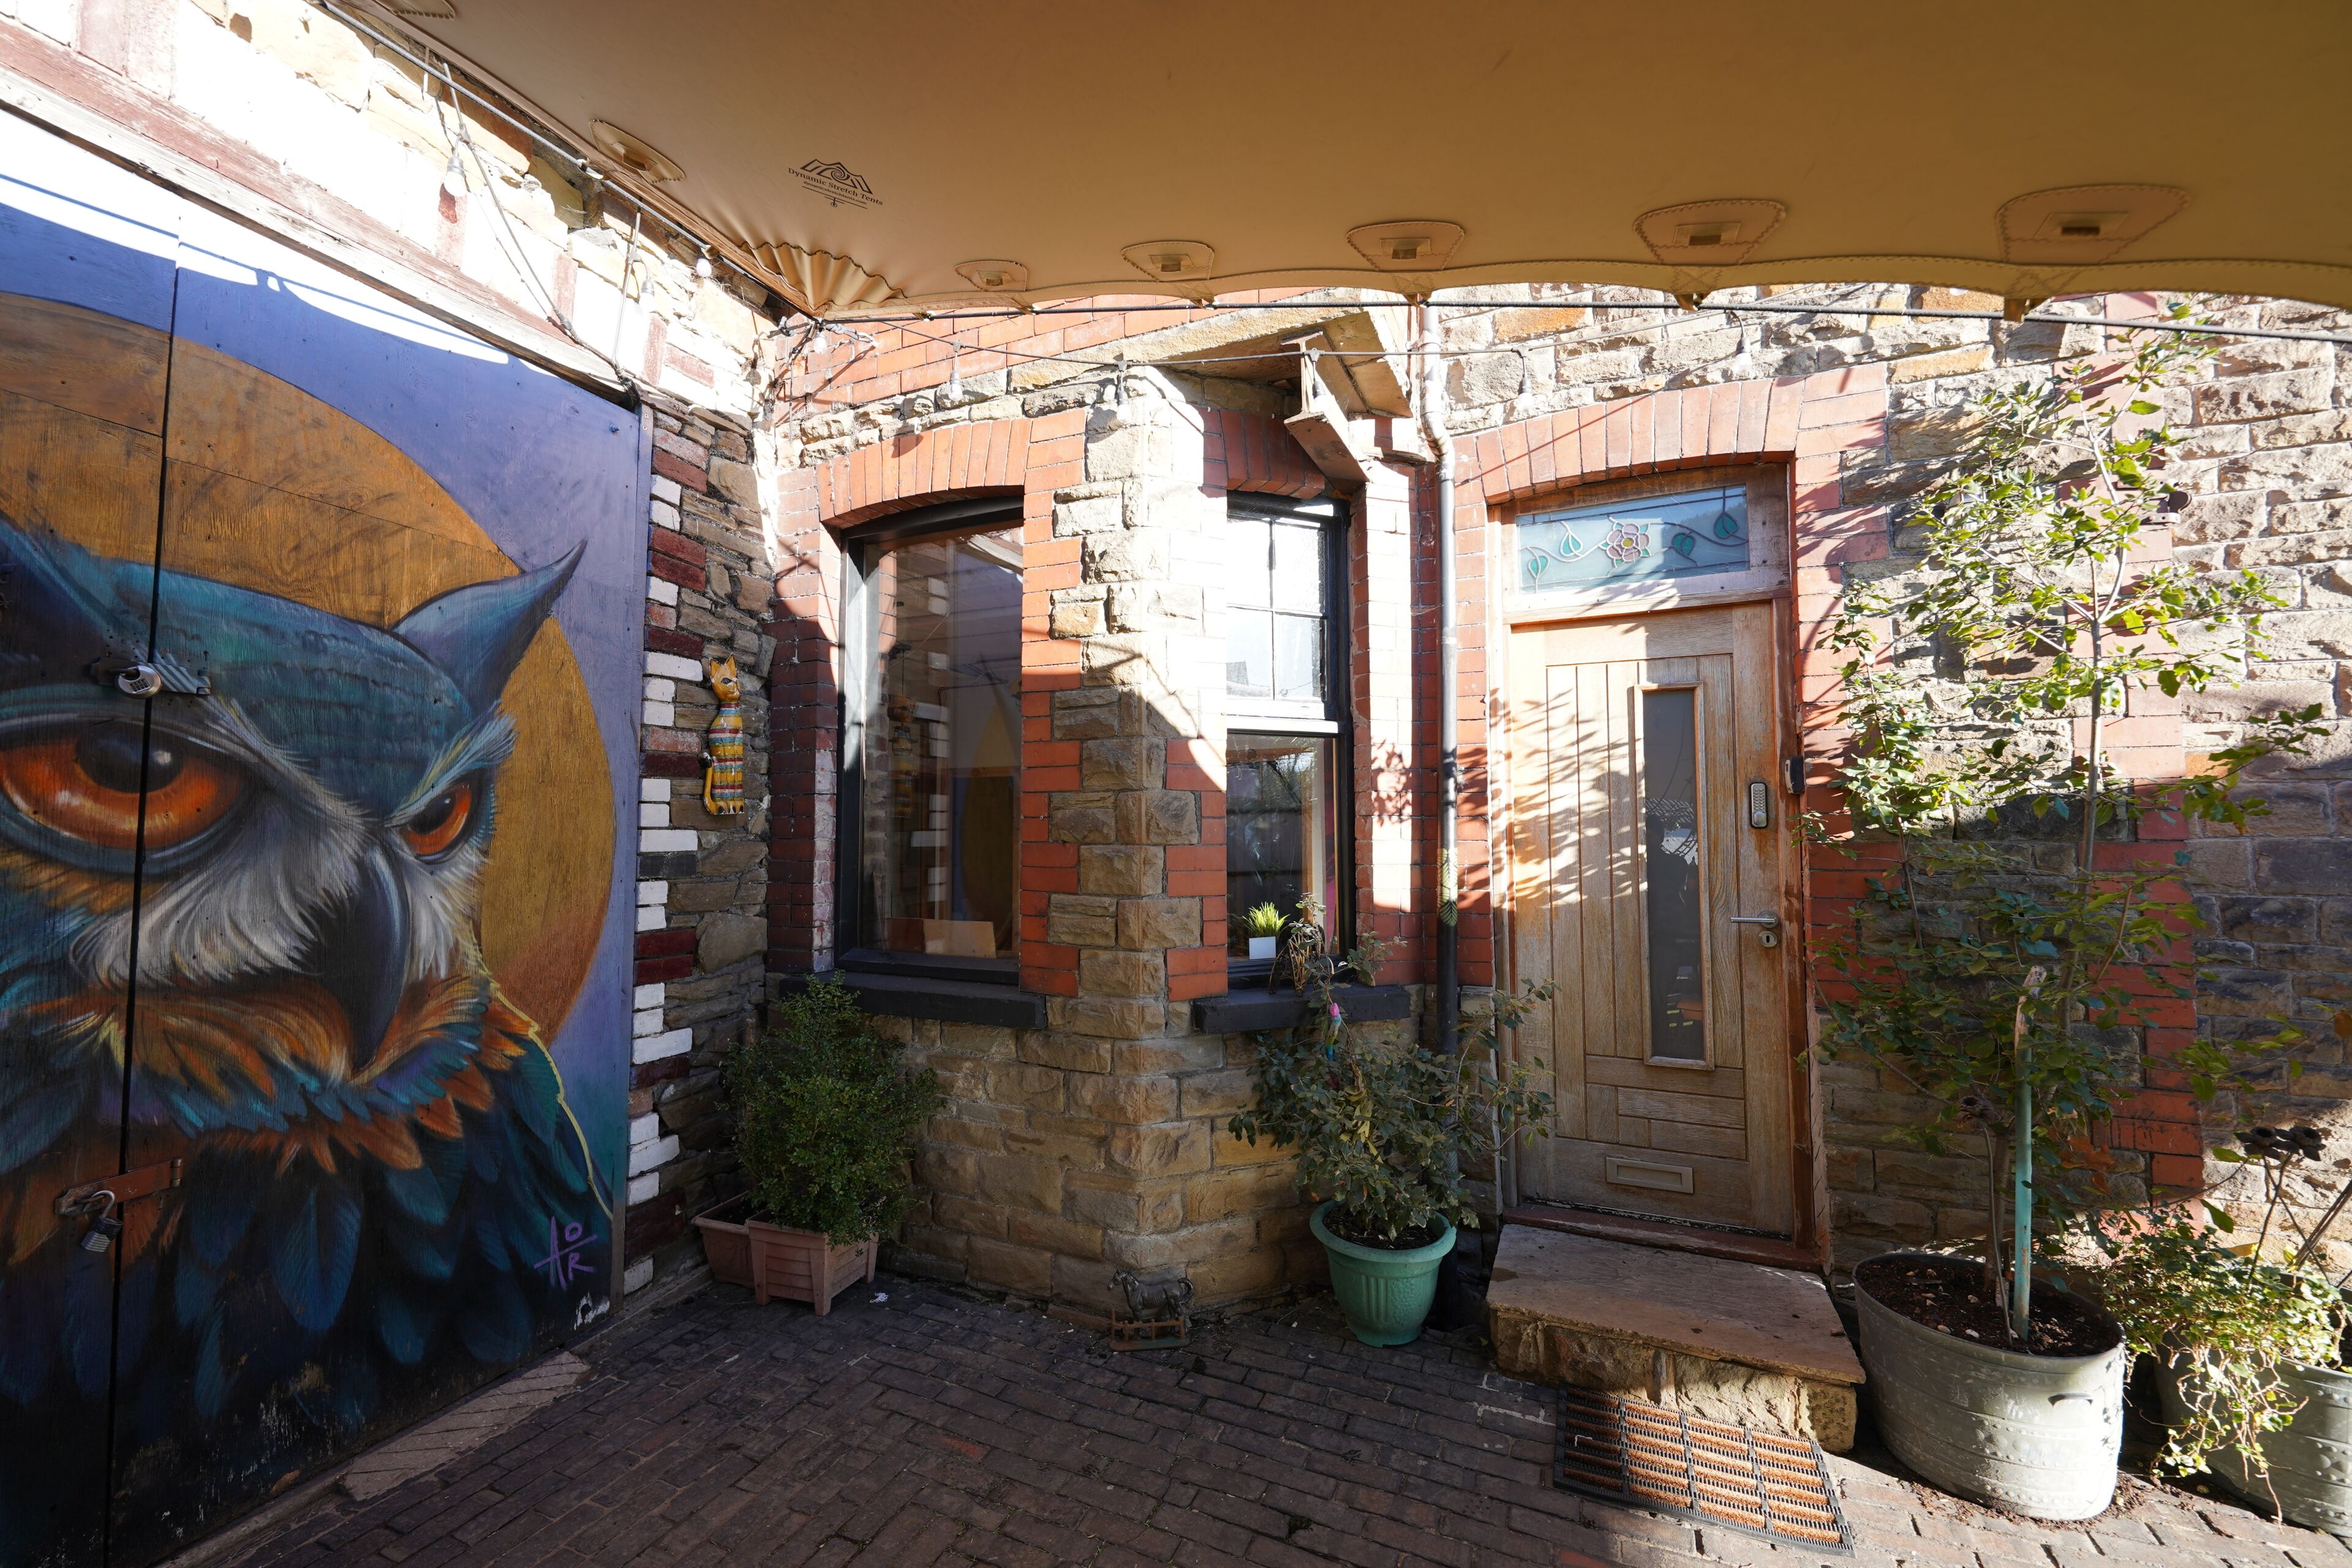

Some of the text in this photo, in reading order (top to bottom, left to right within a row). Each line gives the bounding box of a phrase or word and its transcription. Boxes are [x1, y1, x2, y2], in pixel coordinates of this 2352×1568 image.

[788, 168, 883, 206] Dynamic Stretch Tents
[803, 180, 867, 205] dynamicstretchtents.com
